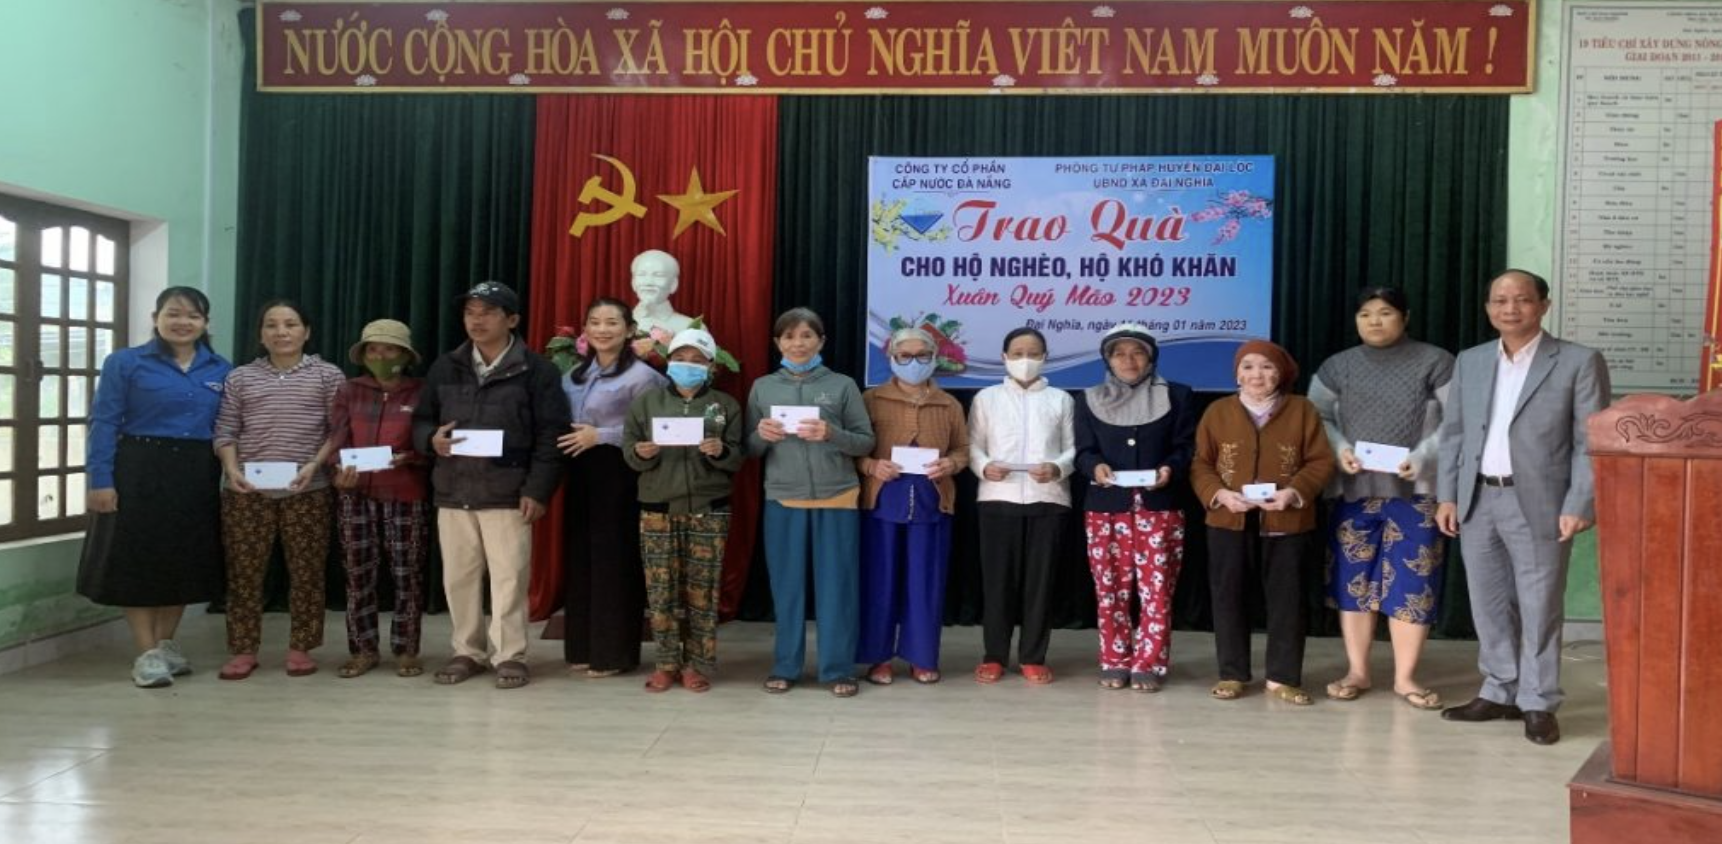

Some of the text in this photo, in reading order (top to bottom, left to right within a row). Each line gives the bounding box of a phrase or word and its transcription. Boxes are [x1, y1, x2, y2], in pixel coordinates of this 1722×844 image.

[283, 11, 393, 76] NƯỚC
[404, 19, 513, 83] CỘNG
[524, 16, 601, 75] HÒA
[613, 19, 668, 75] XÃ
[682, 18, 752, 85] HỘI
[766, 10, 853, 76] CHỦ
[867, 19, 1000, 76] NGHĨA
[1122, 27, 1219, 75] NAM
[1234, 16, 1359, 75] MUÔN
[1372, 19, 1471, 75] NĂM
[933, 163, 948, 174] TY
[953, 199, 1187, 251] Trao Quà
[901, 256, 945, 277] CHO
[952, 252, 983, 281] HỘ
[1080, 252, 1110, 282] HỘ
[1117, 252, 1164, 277] KHÓ
[943, 283, 1001, 306] Xuân
[1010, 283, 1055, 313] Quý
[1126, 287, 1192, 307] 2023
[1218, 319, 1247, 331] 2023
